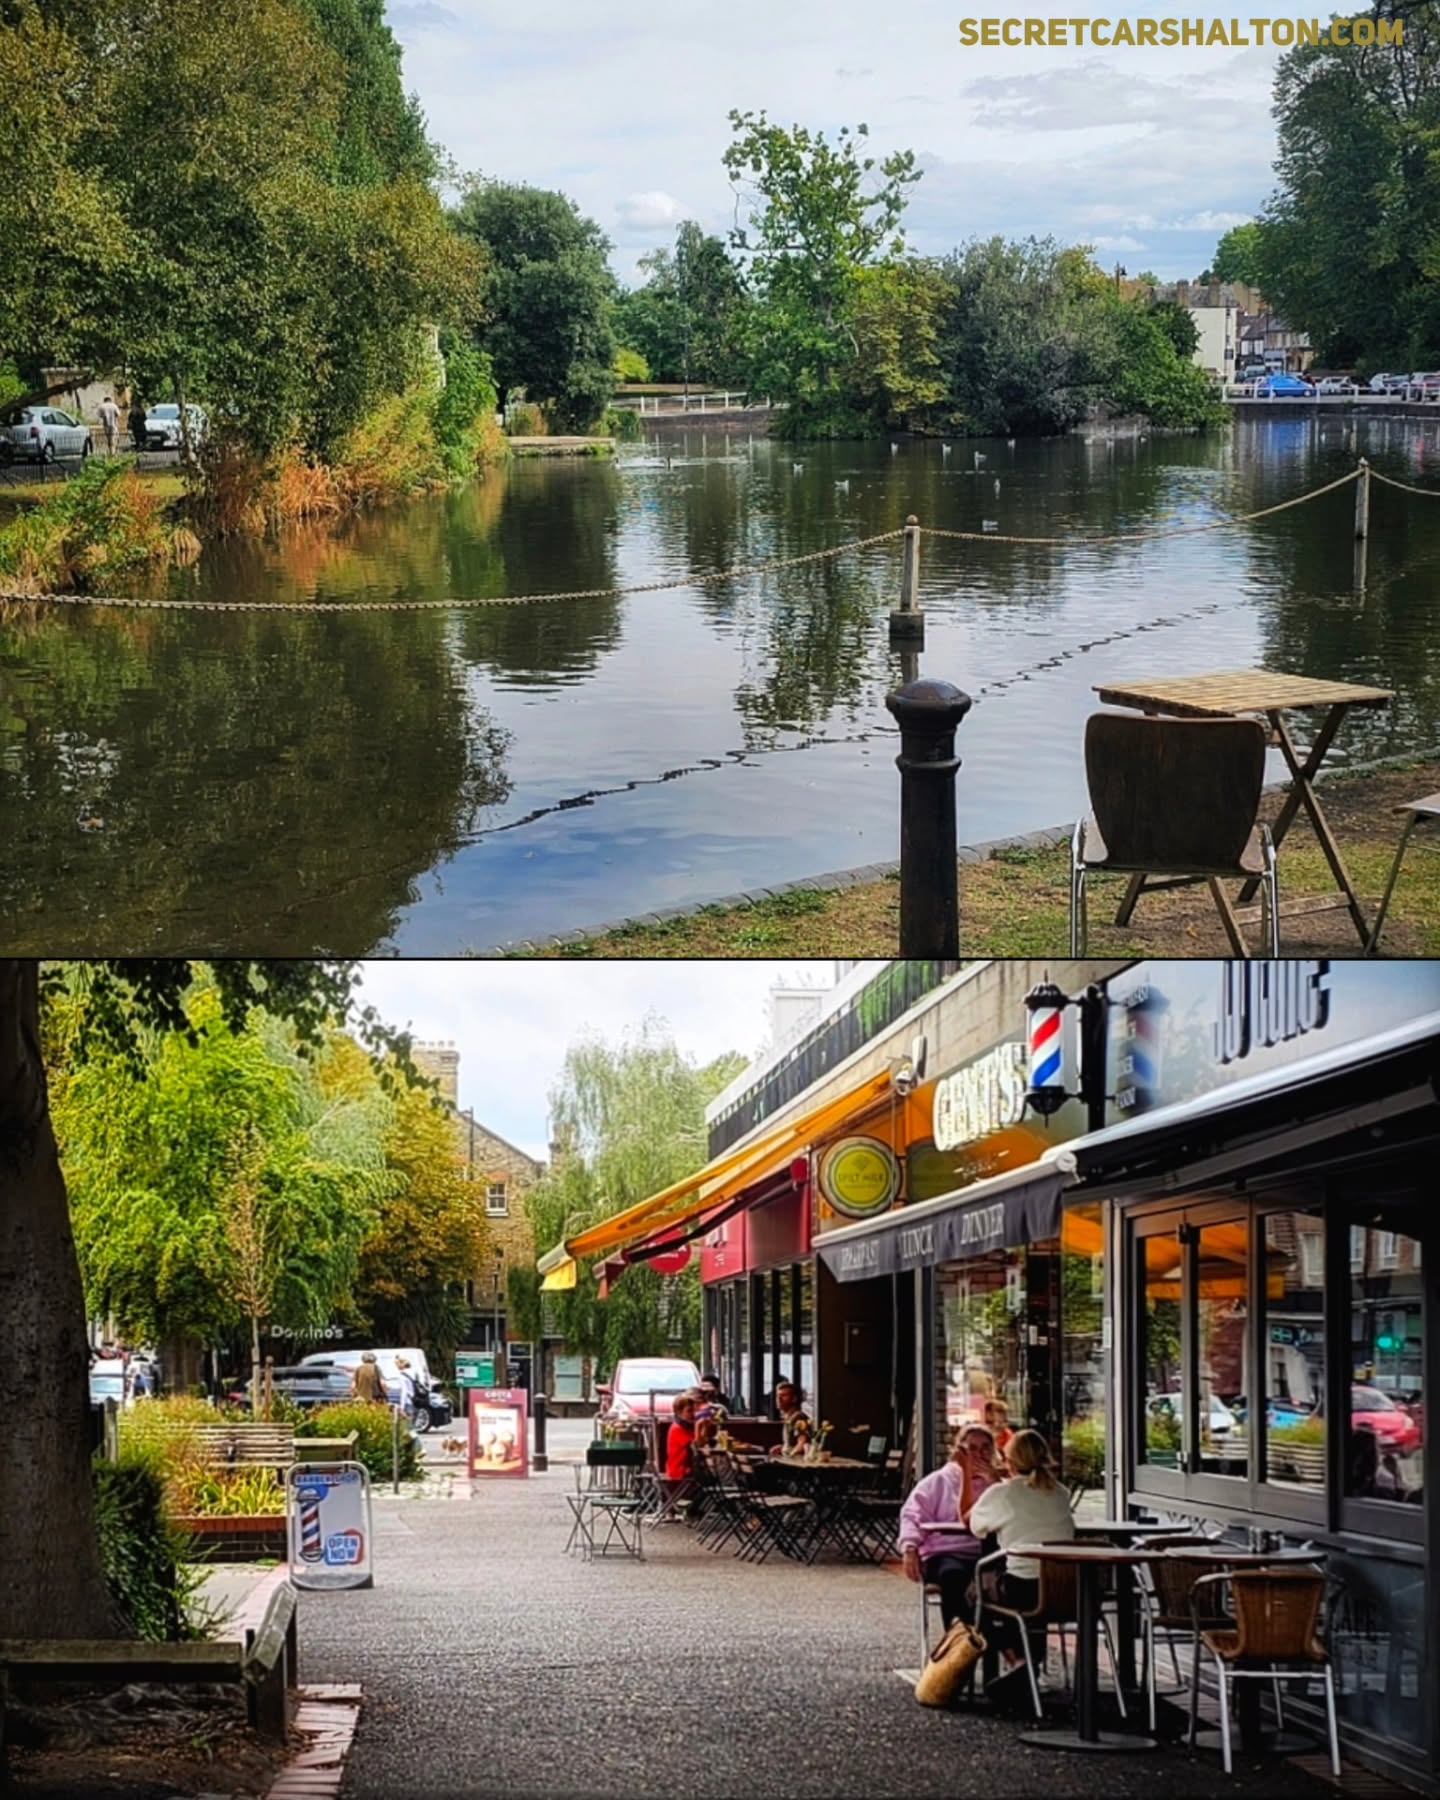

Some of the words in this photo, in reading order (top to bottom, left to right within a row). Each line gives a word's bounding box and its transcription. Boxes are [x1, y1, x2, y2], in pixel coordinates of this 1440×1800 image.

[900, 1224, 935, 1259] LUNCH
[960, 1202, 1005, 1245] DINNER
[328, 1537, 358, 1550] OPEN
[330, 1549, 355, 1560] NOW
